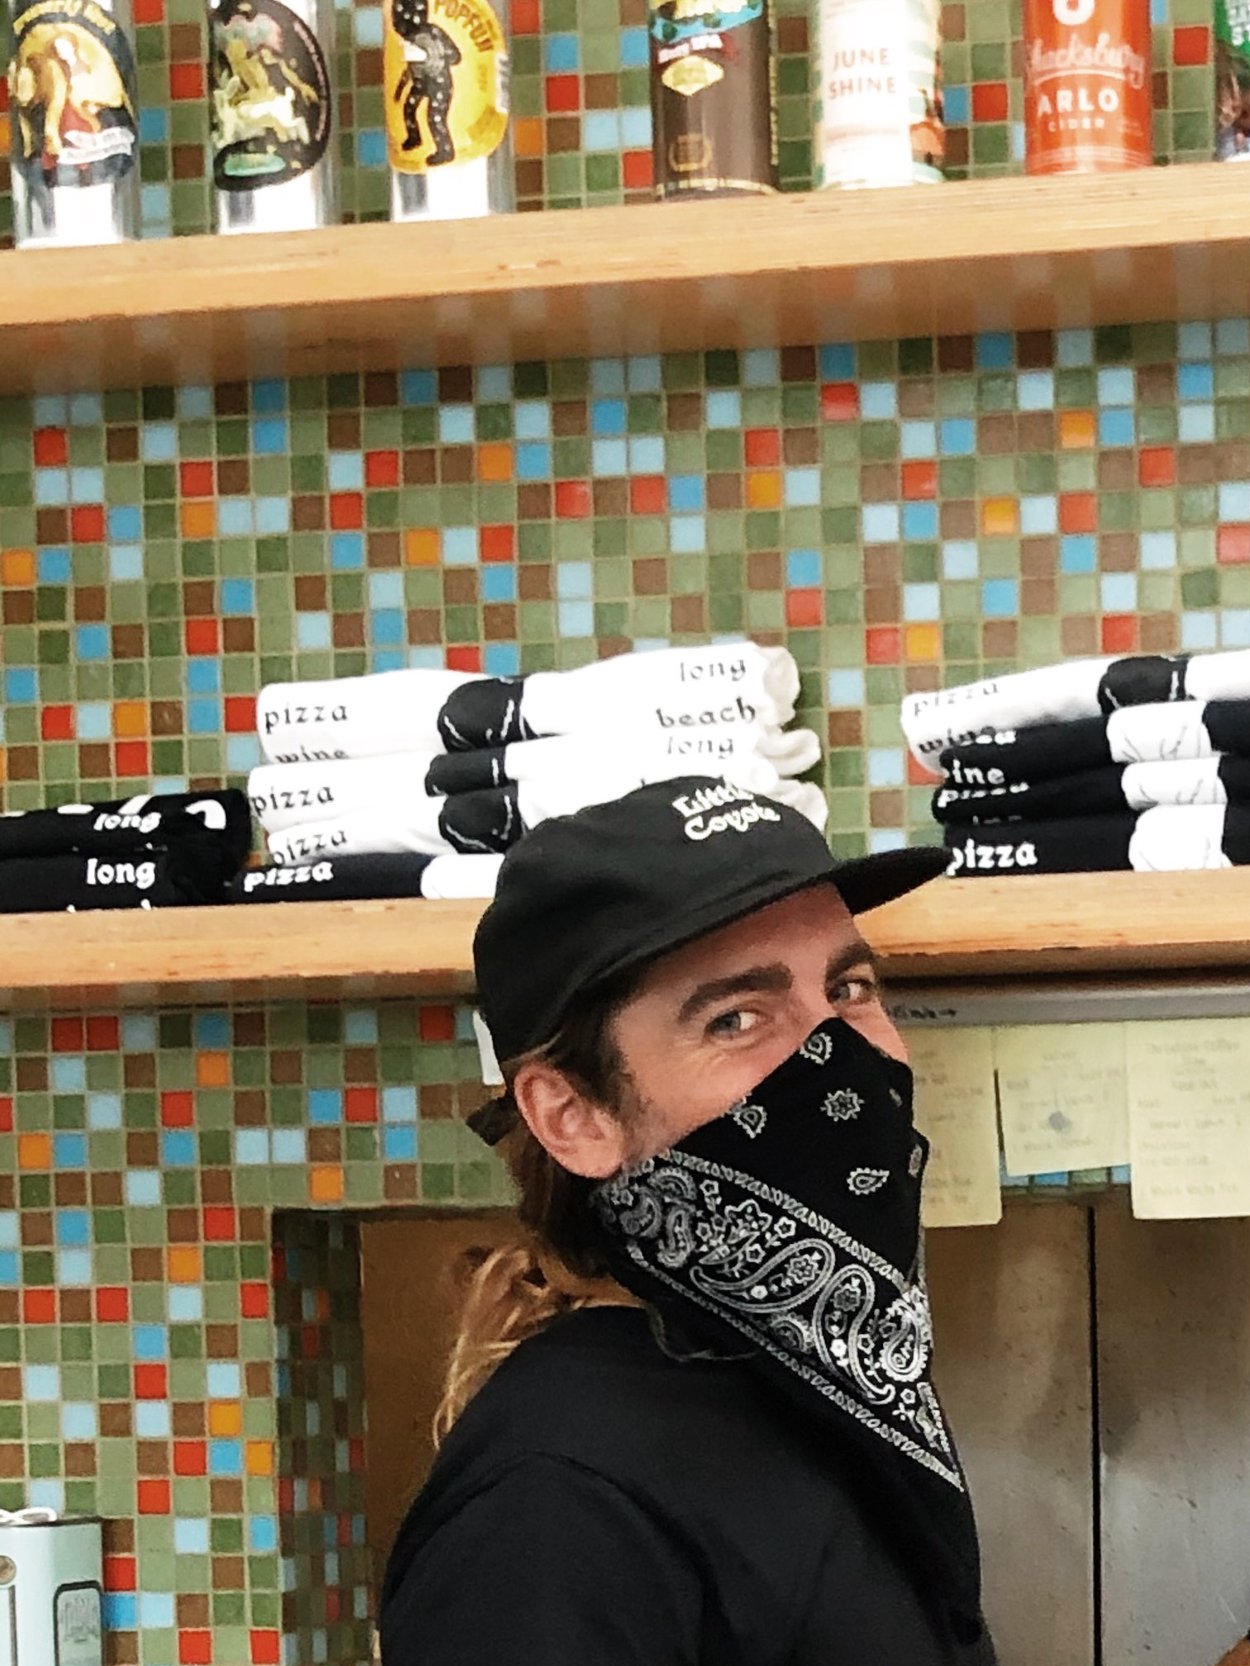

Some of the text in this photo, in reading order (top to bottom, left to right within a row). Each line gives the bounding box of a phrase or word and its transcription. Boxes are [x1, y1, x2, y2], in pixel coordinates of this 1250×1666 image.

[833, 47, 890, 71] JUNE
[828, 75, 897, 100] SHINE
[1036, 87, 1120, 118] ARLO
[265, 702, 349, 735] pizza
[656, 696, 757, 728] beach
[944, 758, 1006, 785] ine
[251, 786, 335, 818] pizza
[684, 802, 782, 841] Coyote
[86, 857, 156, 889] long
[243, 860, 335, 893] pizza
